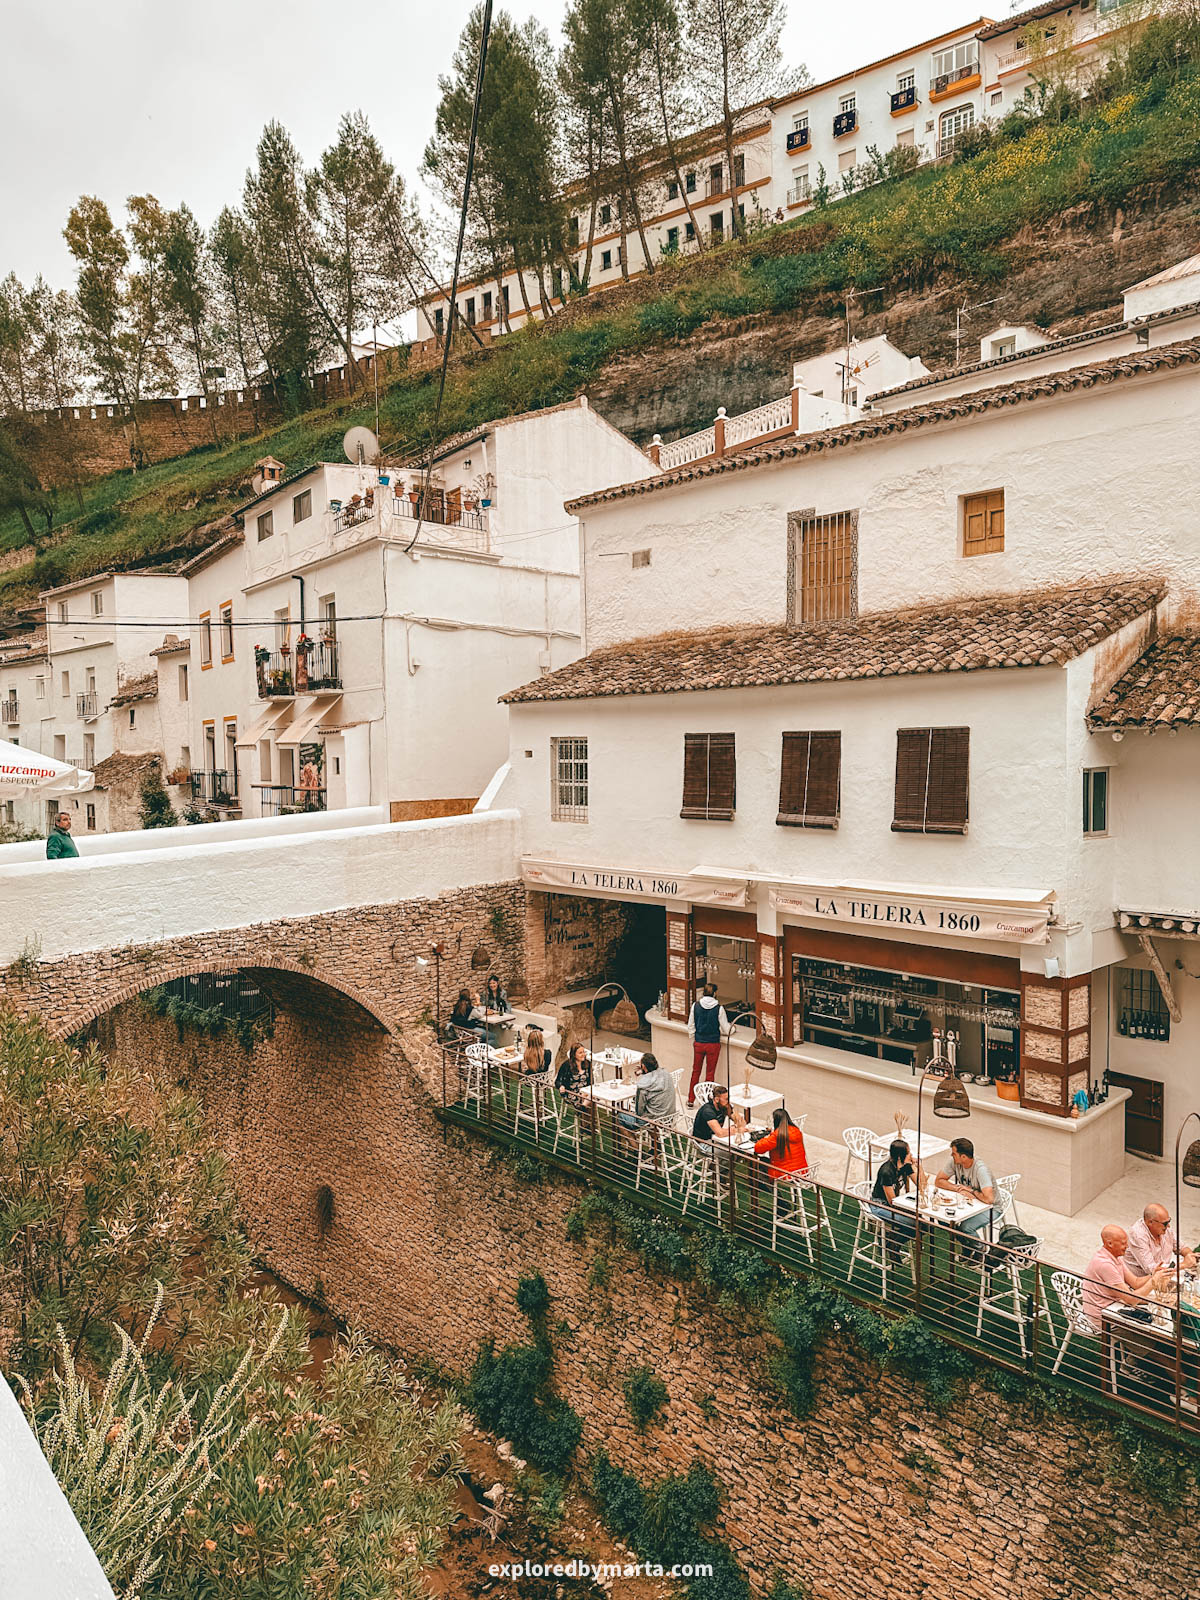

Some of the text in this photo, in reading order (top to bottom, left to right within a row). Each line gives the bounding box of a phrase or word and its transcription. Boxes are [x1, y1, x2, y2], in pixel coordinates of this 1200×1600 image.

[0, 765, 56, 778] uzcampo
[0, 776, 40, 786] ESPECIAL
[571, 871, 678, 896] LA TELERA 1860
[815, 897, 980, 932] LA TELERA 1860
[996, 922, 1034, 934] Cruzcampo
